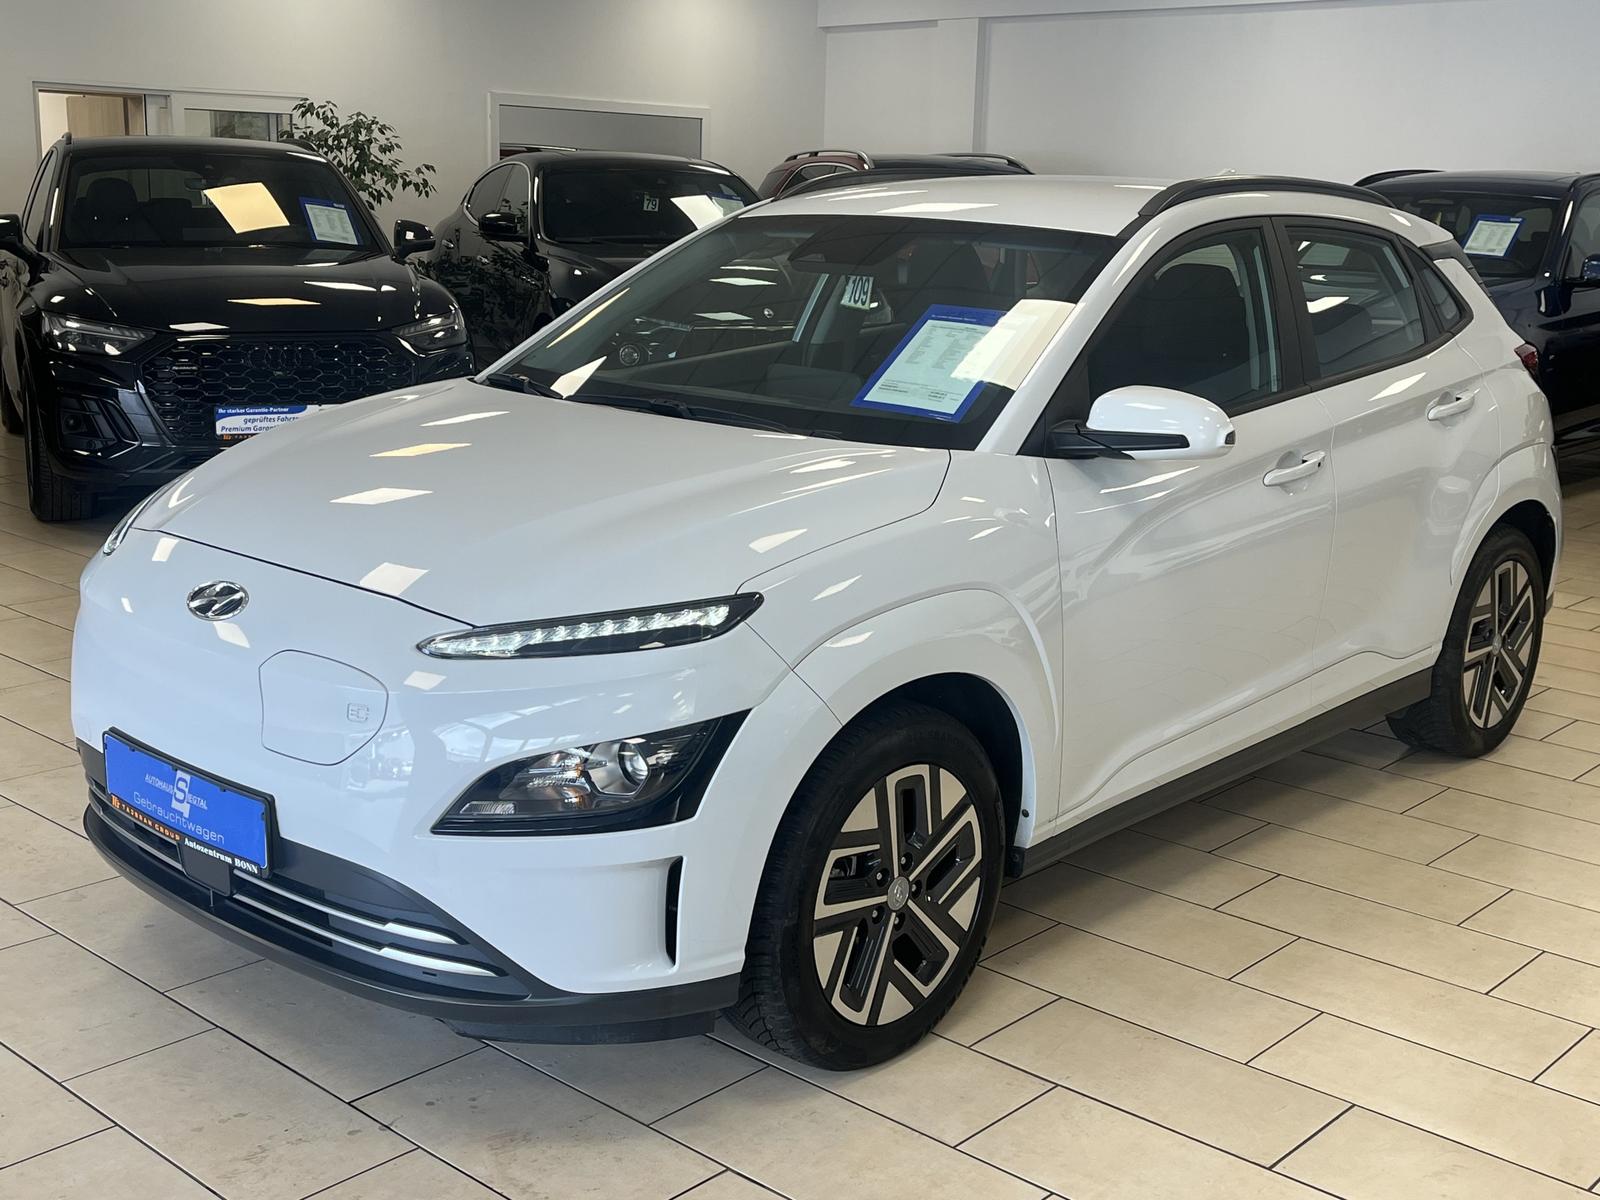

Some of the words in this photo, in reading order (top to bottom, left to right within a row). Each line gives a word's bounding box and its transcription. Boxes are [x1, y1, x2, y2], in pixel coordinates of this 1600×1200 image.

[646, 198, 657, 210] 79
[848, 276, 870, 306] 109
[243, 416, 276, 425] geprüftes
[133, 791, 225, 844] Gebrauchtwagen
[184, 837, 232, 864] Autozentrum
[234, 857, 258, 874] BONN
